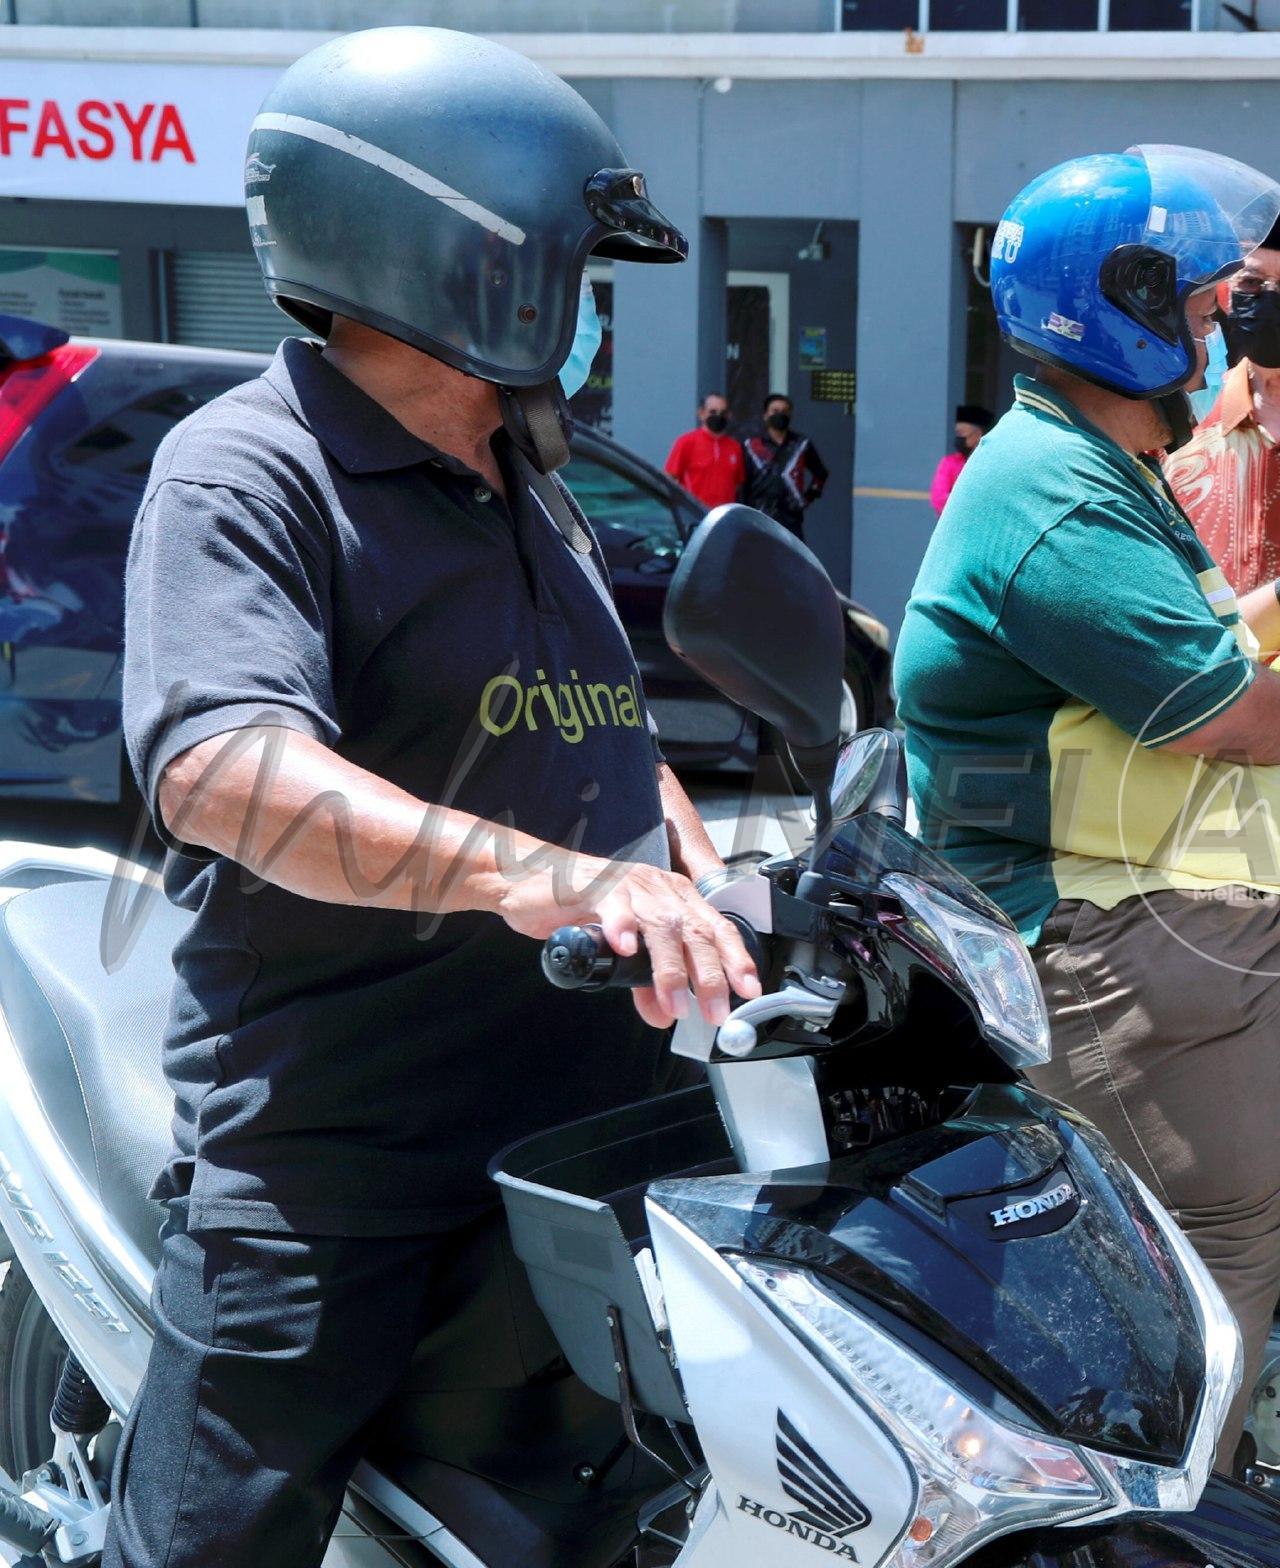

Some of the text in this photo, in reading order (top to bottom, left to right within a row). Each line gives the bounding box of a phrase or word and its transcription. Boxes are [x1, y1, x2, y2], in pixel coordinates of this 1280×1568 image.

[0, 98, 197, 164] FASYA
[479, 668, 645, 745] Original
[990, 1183, 1080, 1227] HONDA
[736, 1494, 861, 1565] HONDA
